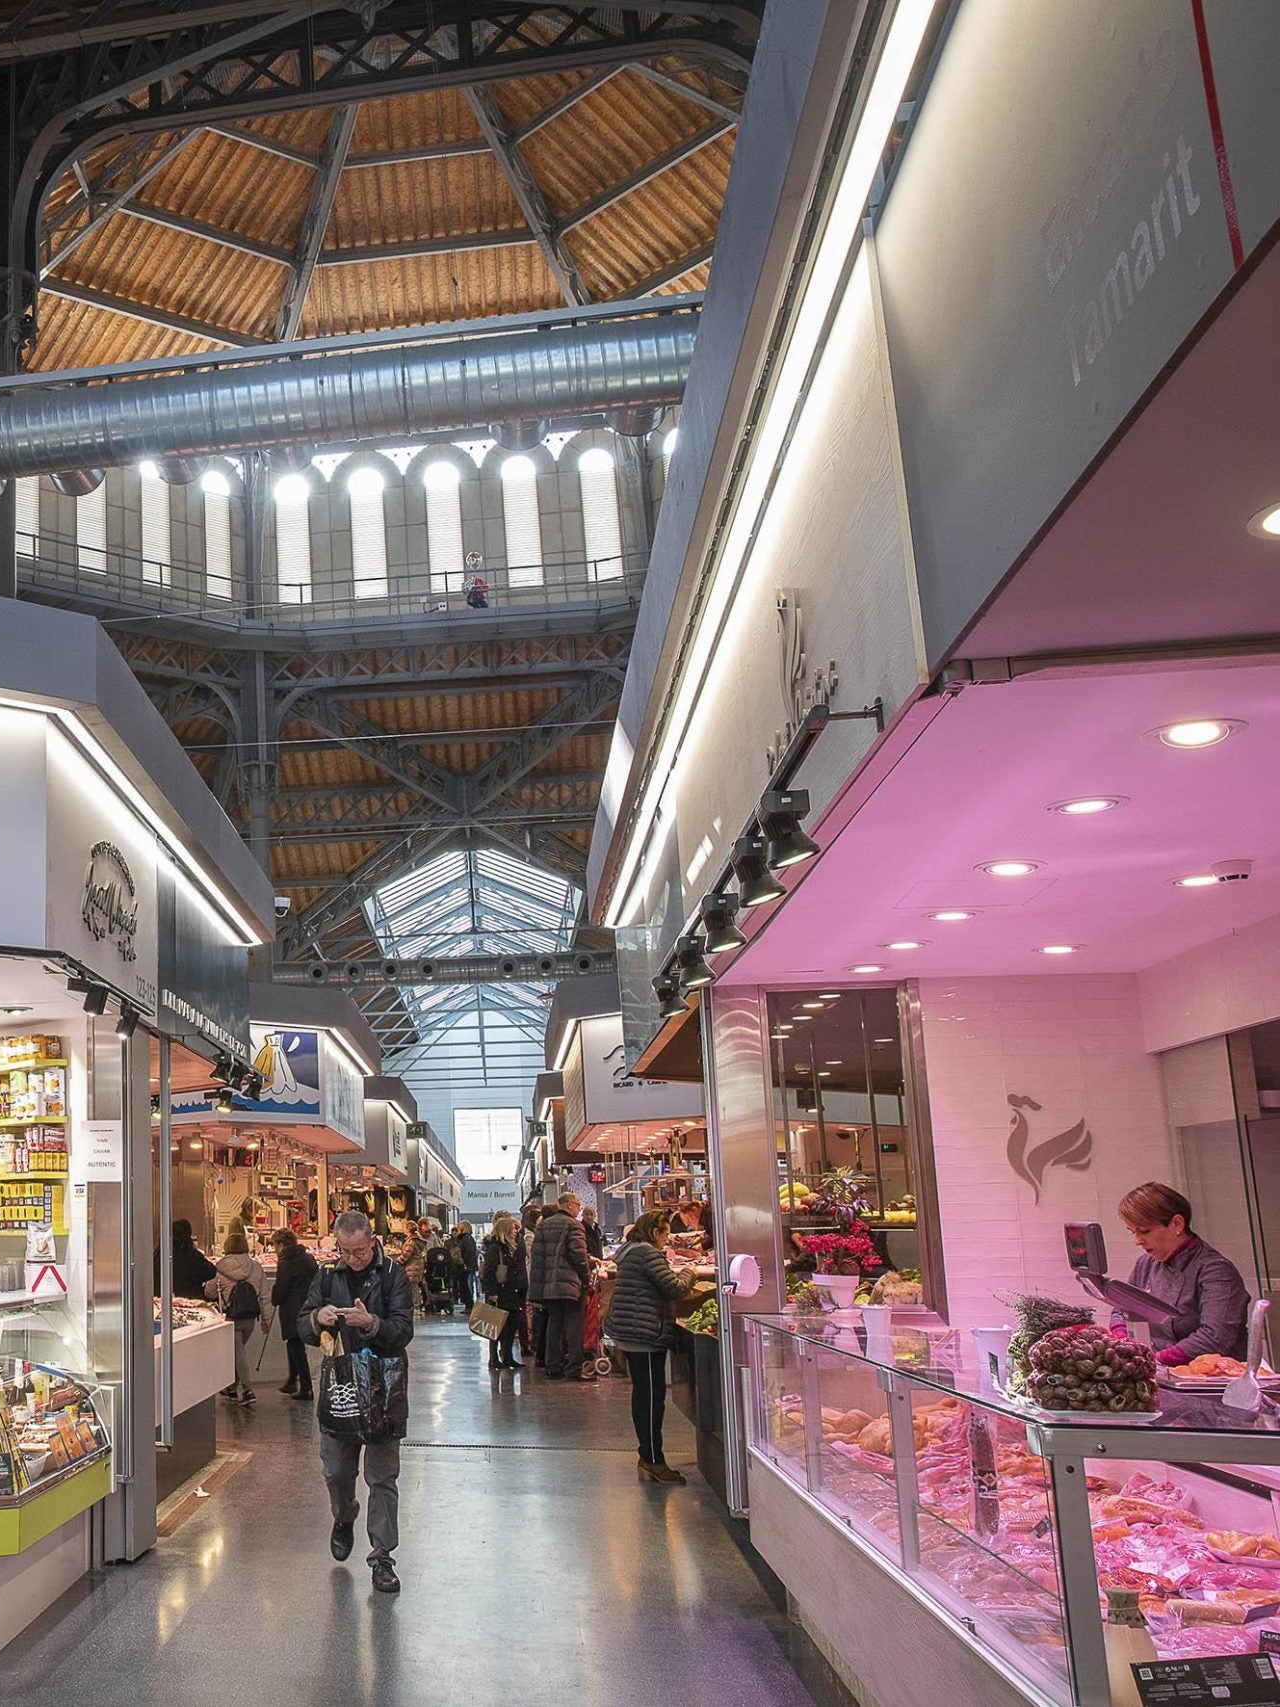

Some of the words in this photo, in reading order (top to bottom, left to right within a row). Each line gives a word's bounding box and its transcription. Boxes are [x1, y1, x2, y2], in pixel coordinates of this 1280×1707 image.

[135, 974, 156, 1007] 123-125
[467, 1191, 489, 1199] Manso
[493, 1191, 516, 1199] Borrell
